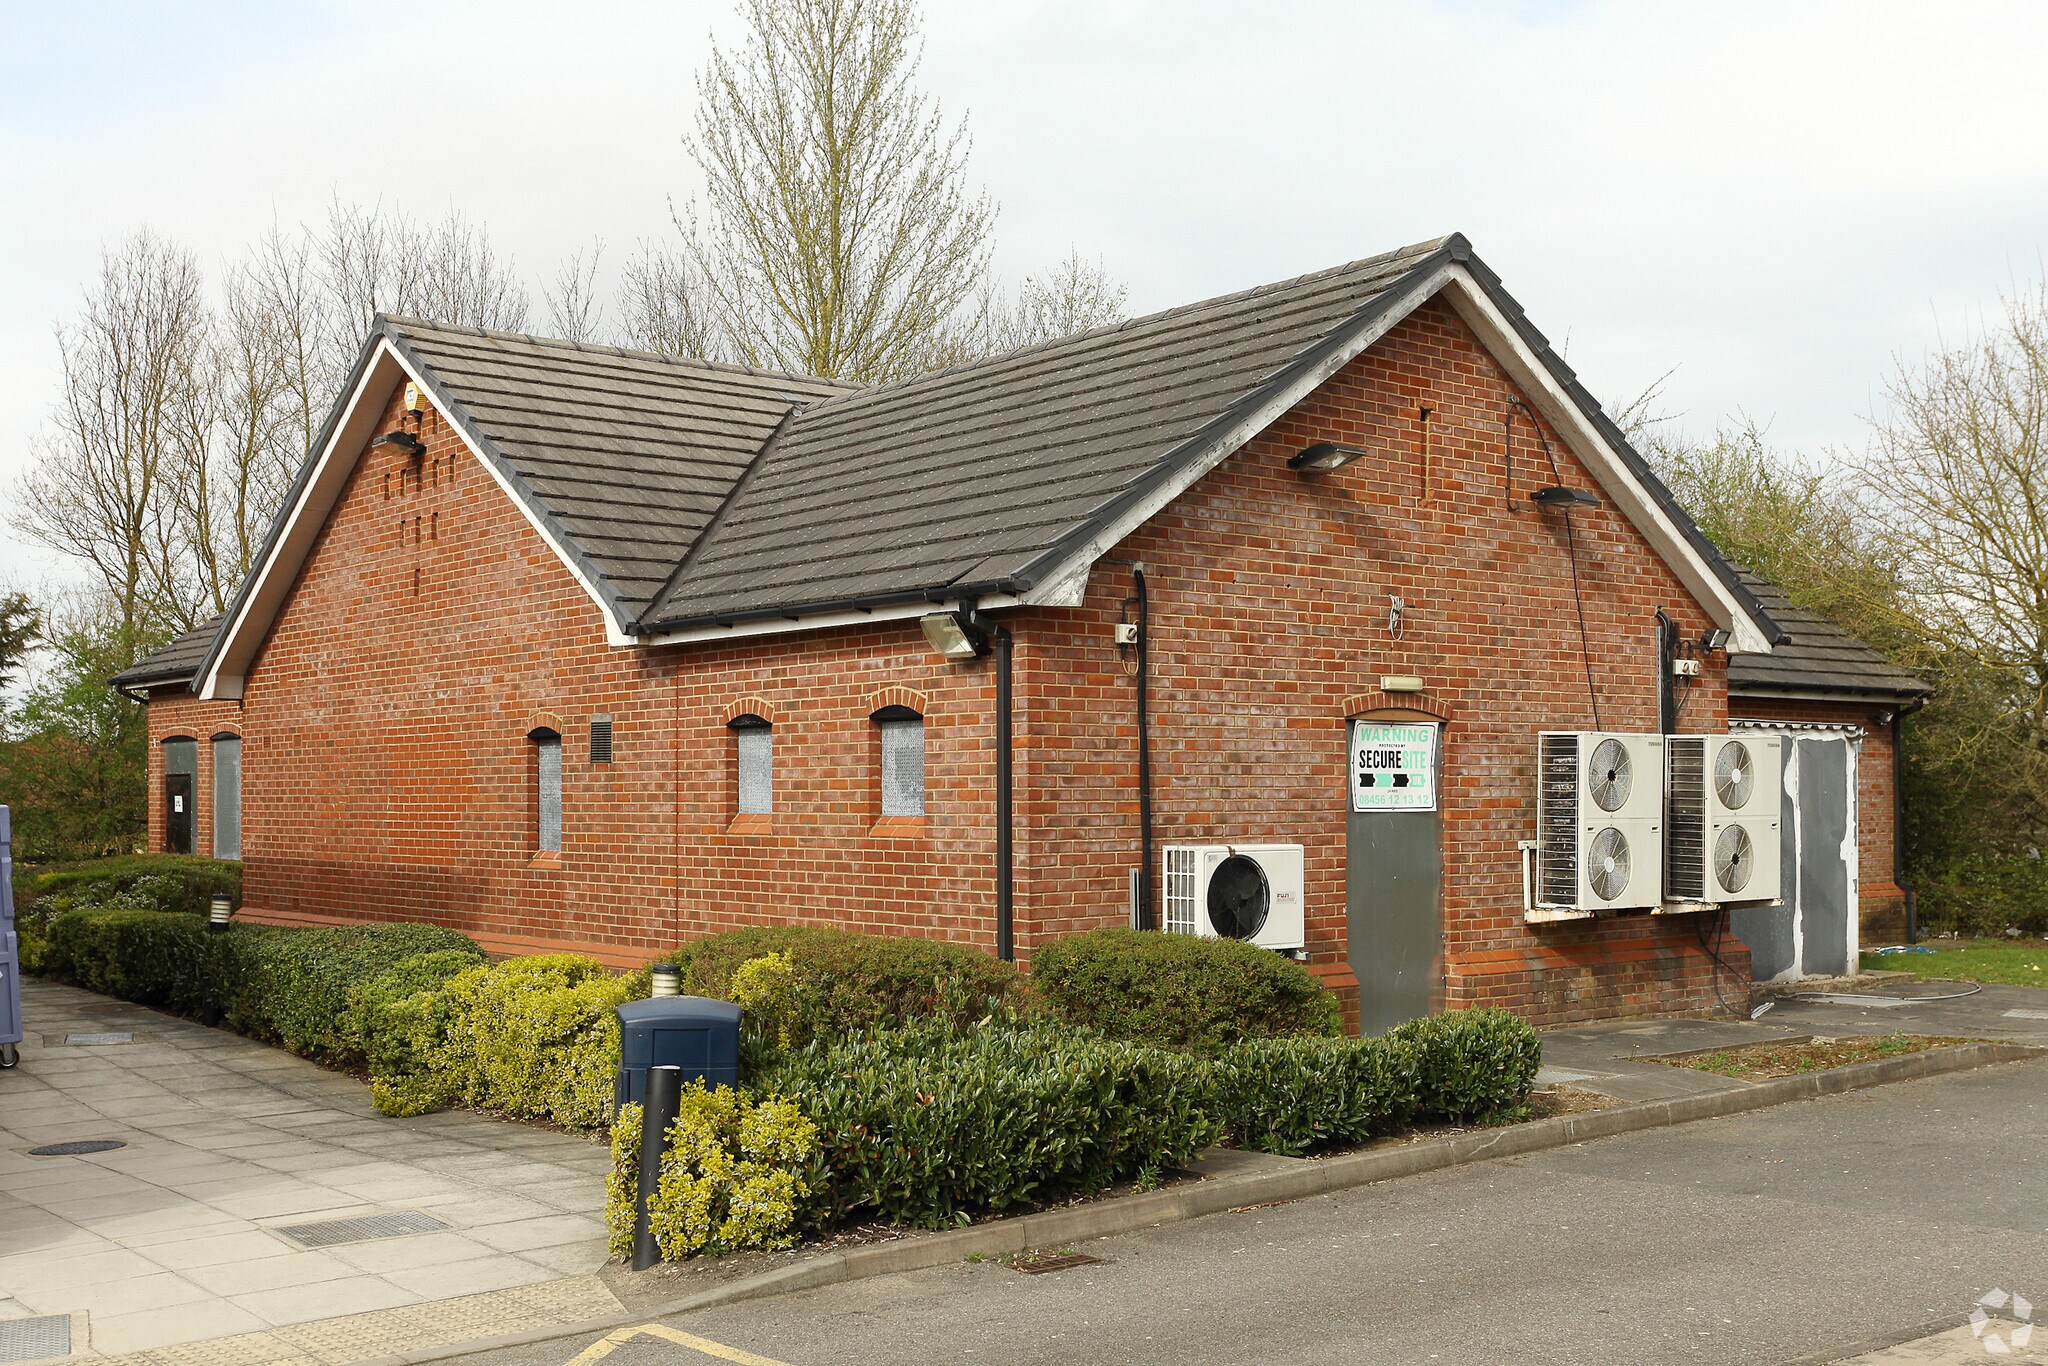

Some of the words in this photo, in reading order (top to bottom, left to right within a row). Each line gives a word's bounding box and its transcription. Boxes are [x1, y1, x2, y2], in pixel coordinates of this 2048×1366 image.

[1361, 727, 1429, 742] WARNING
[1412, 776, 1422, 785] UK
[1360, 794, 1385, 804] 08456
[1389, 795, 1400, 804] 12
[1403, 795, 1414, 804] 13
[1418, 795, 1429, 804] 12
